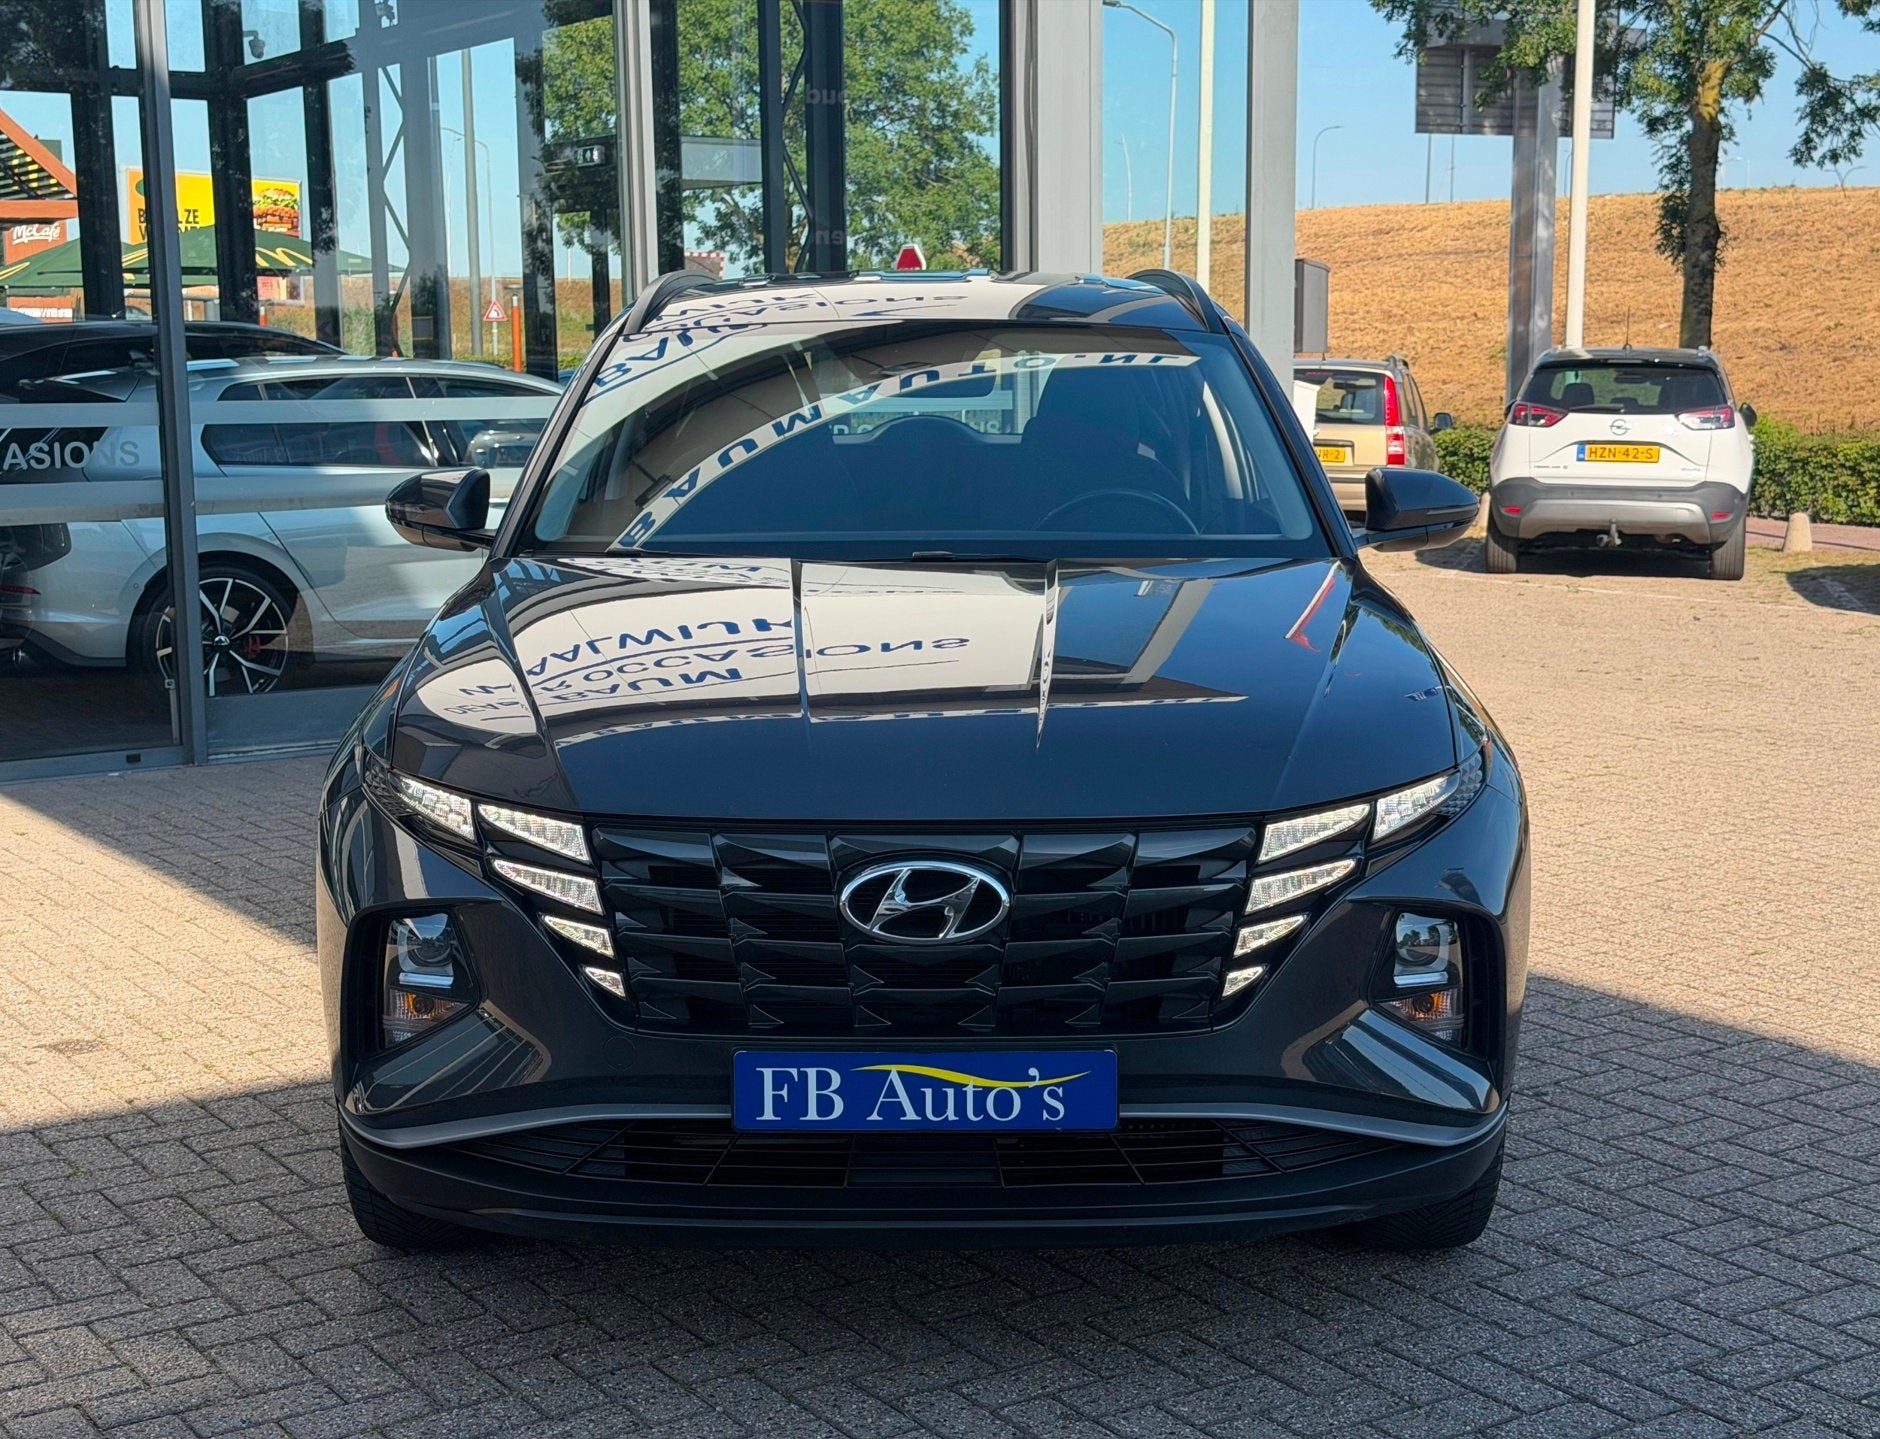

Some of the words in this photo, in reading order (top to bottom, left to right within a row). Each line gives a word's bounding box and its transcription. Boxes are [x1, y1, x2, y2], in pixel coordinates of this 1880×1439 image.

[184, 208, 200, 225] ZE
[1588, 446, 1654, 460] HZN-42-S
[755, 1066, 845, 1122] FB
